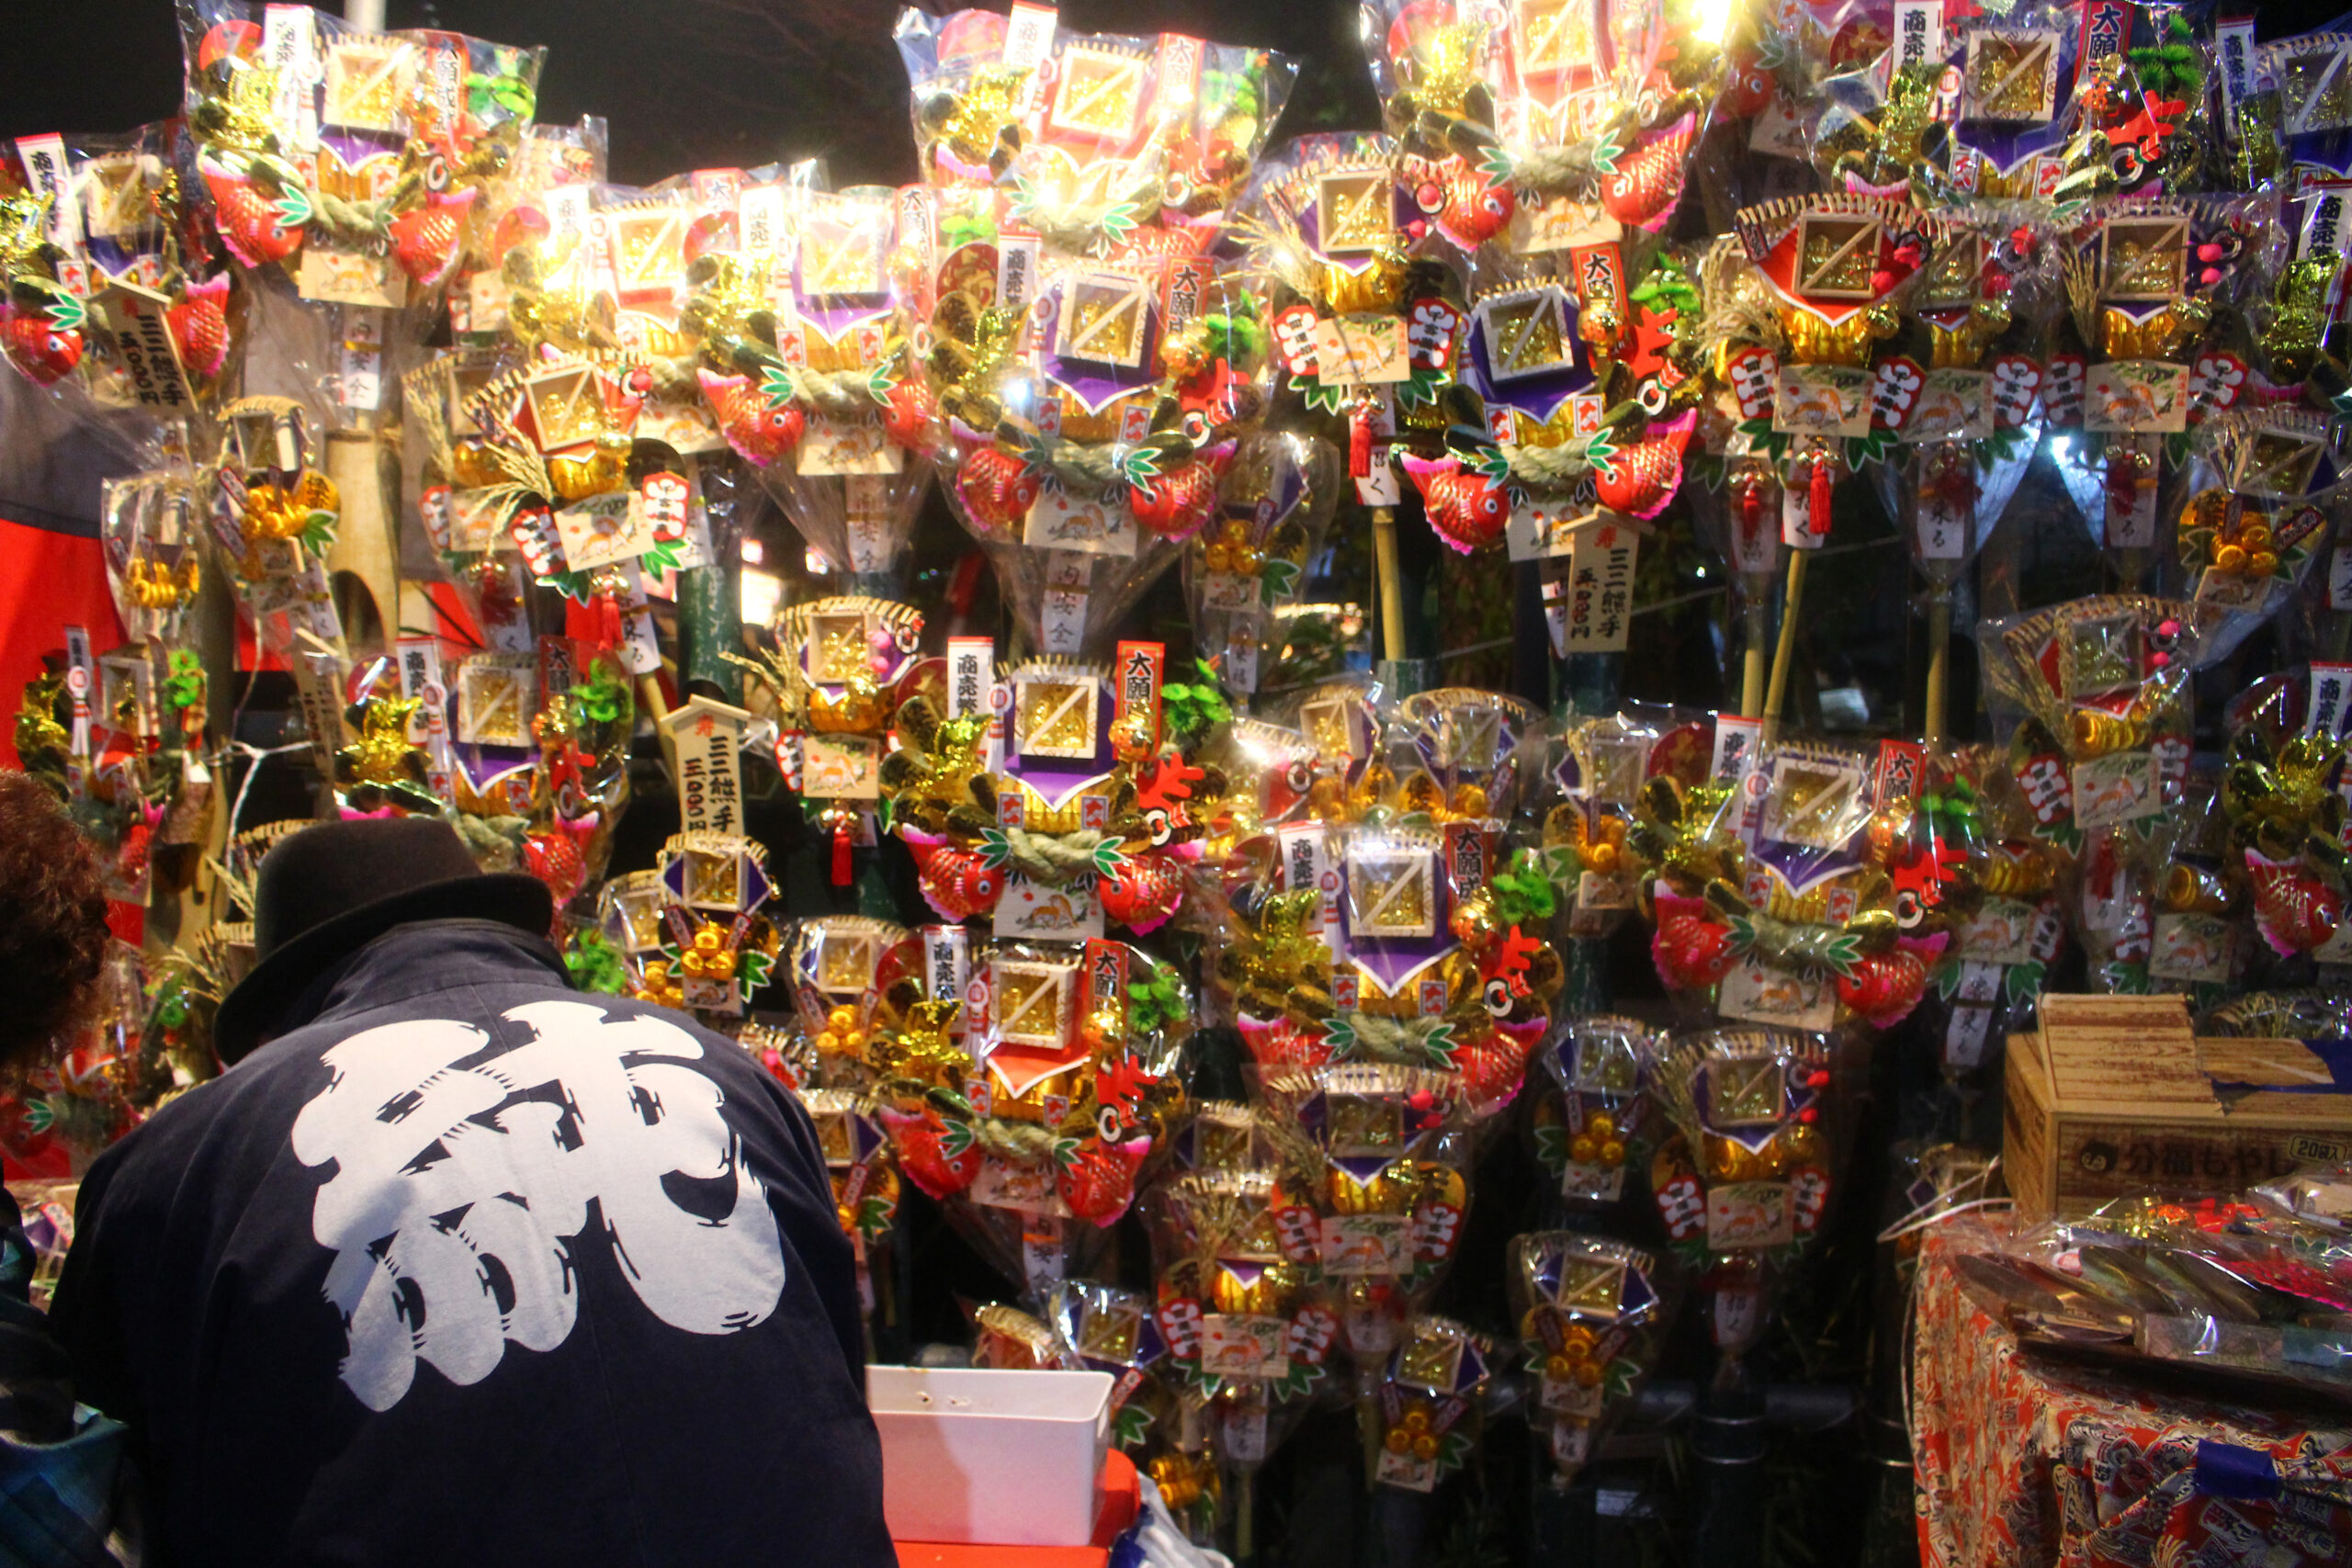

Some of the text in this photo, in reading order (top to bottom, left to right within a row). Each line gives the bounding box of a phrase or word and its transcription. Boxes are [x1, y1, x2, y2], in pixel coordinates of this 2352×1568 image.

[1904, 9, 1927, 65] 商売
[2088, 5, 2122, 75] 大願
[1126, 652, 1153, 715] 大願
[1292, 840, 1315, 889] 商売
[1094, 951, 1118, 1009] 大願
